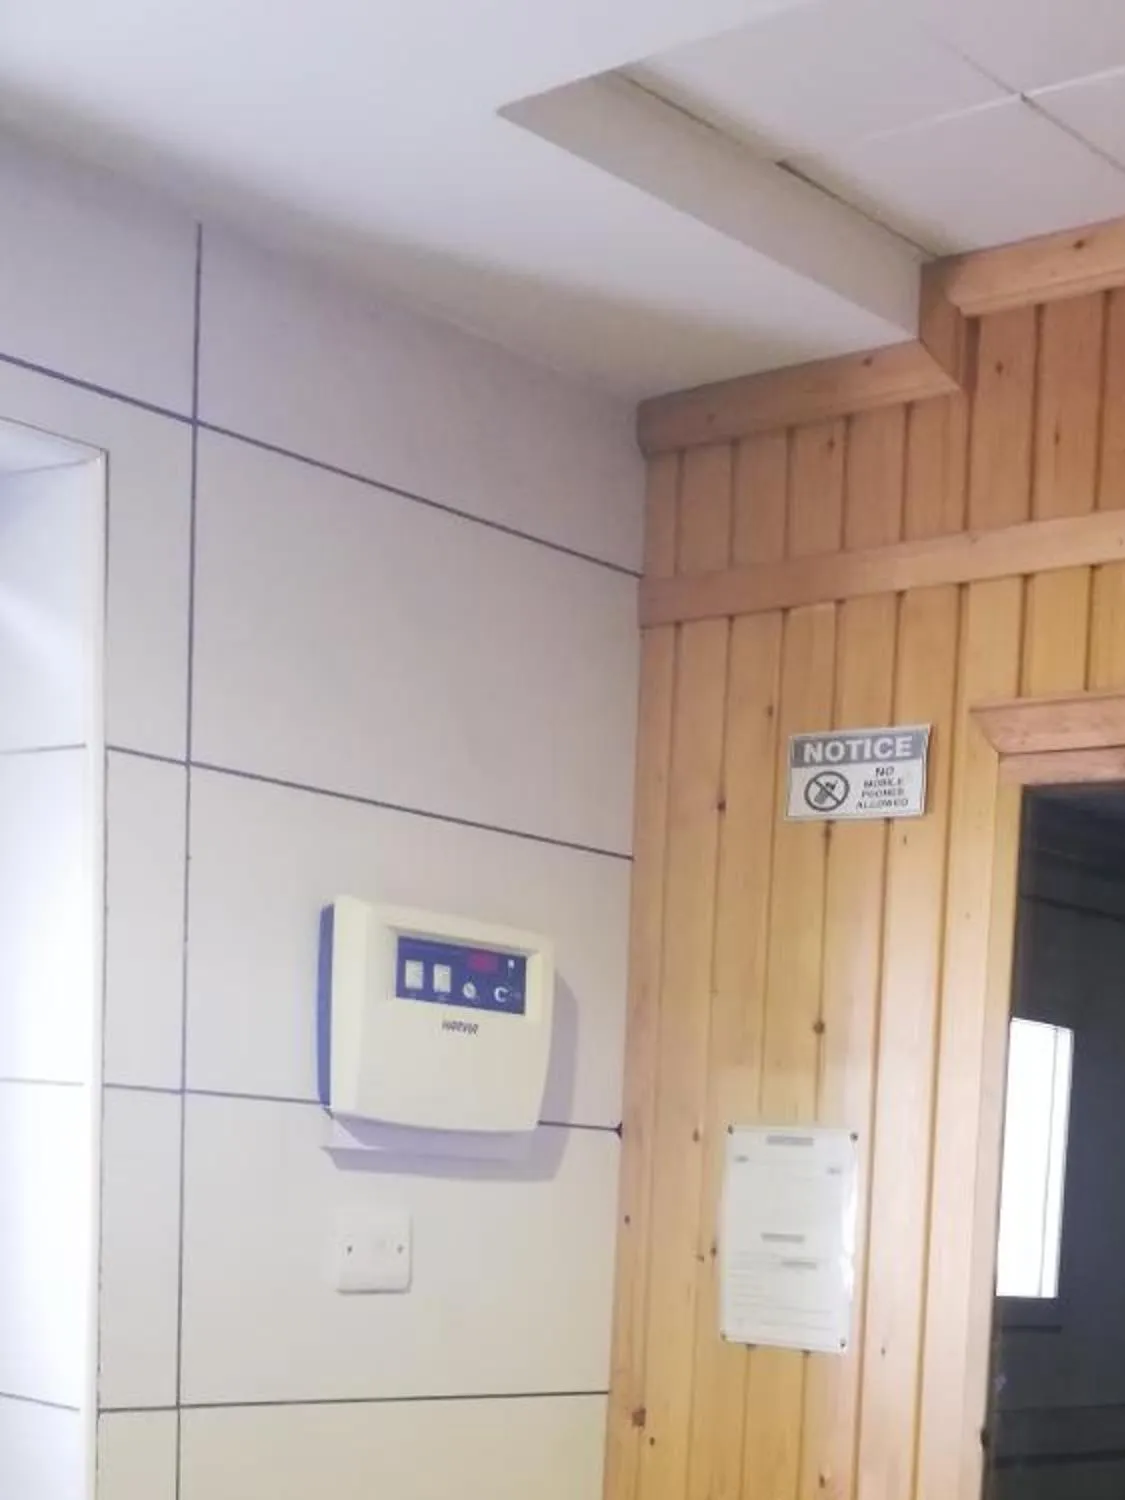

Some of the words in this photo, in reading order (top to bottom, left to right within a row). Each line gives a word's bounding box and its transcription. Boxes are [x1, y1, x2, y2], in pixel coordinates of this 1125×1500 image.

[803, 736, 913, 763] NOTICE
[875, 766, 895, 777] NO
[856, 798, 909, 809] ALLOWED
